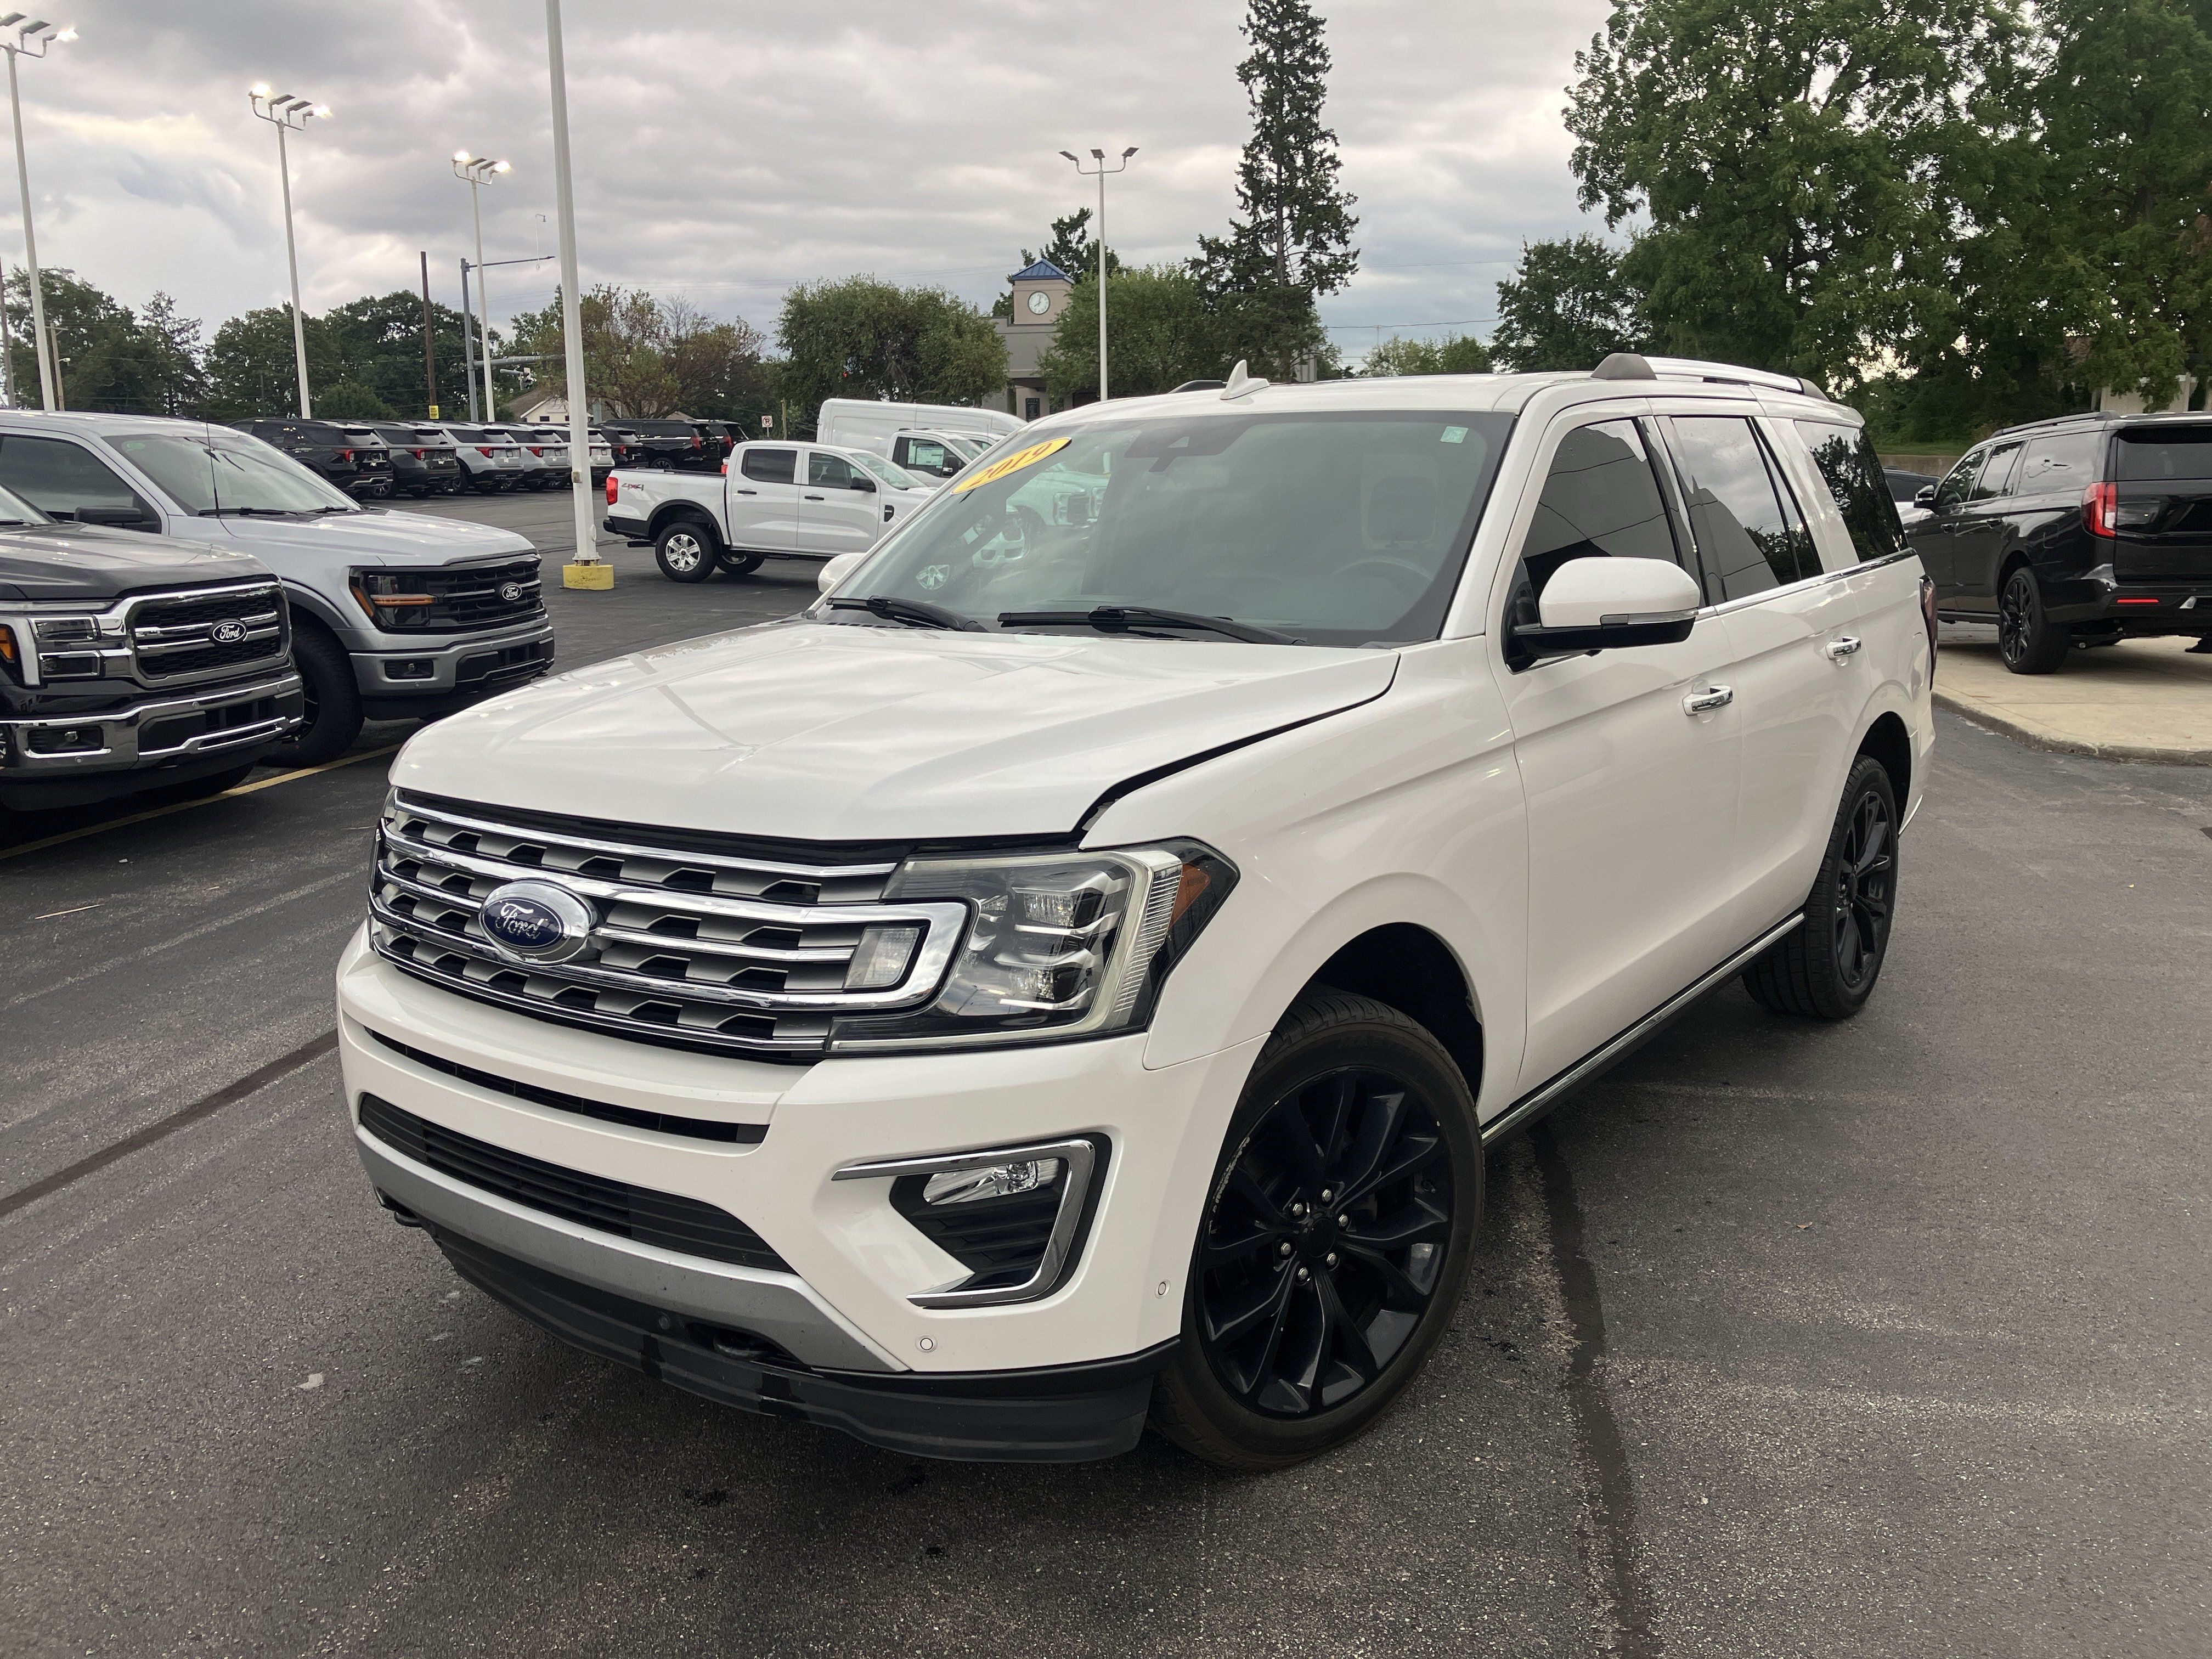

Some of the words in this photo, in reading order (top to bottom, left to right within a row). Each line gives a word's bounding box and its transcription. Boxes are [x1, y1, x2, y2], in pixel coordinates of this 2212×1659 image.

[966, 443, 1052, 489] 2019
[506, 586, 519, 598] Ford
[219, 625, 240, 639] Ford
[495, 902, 544, 939] Ford
